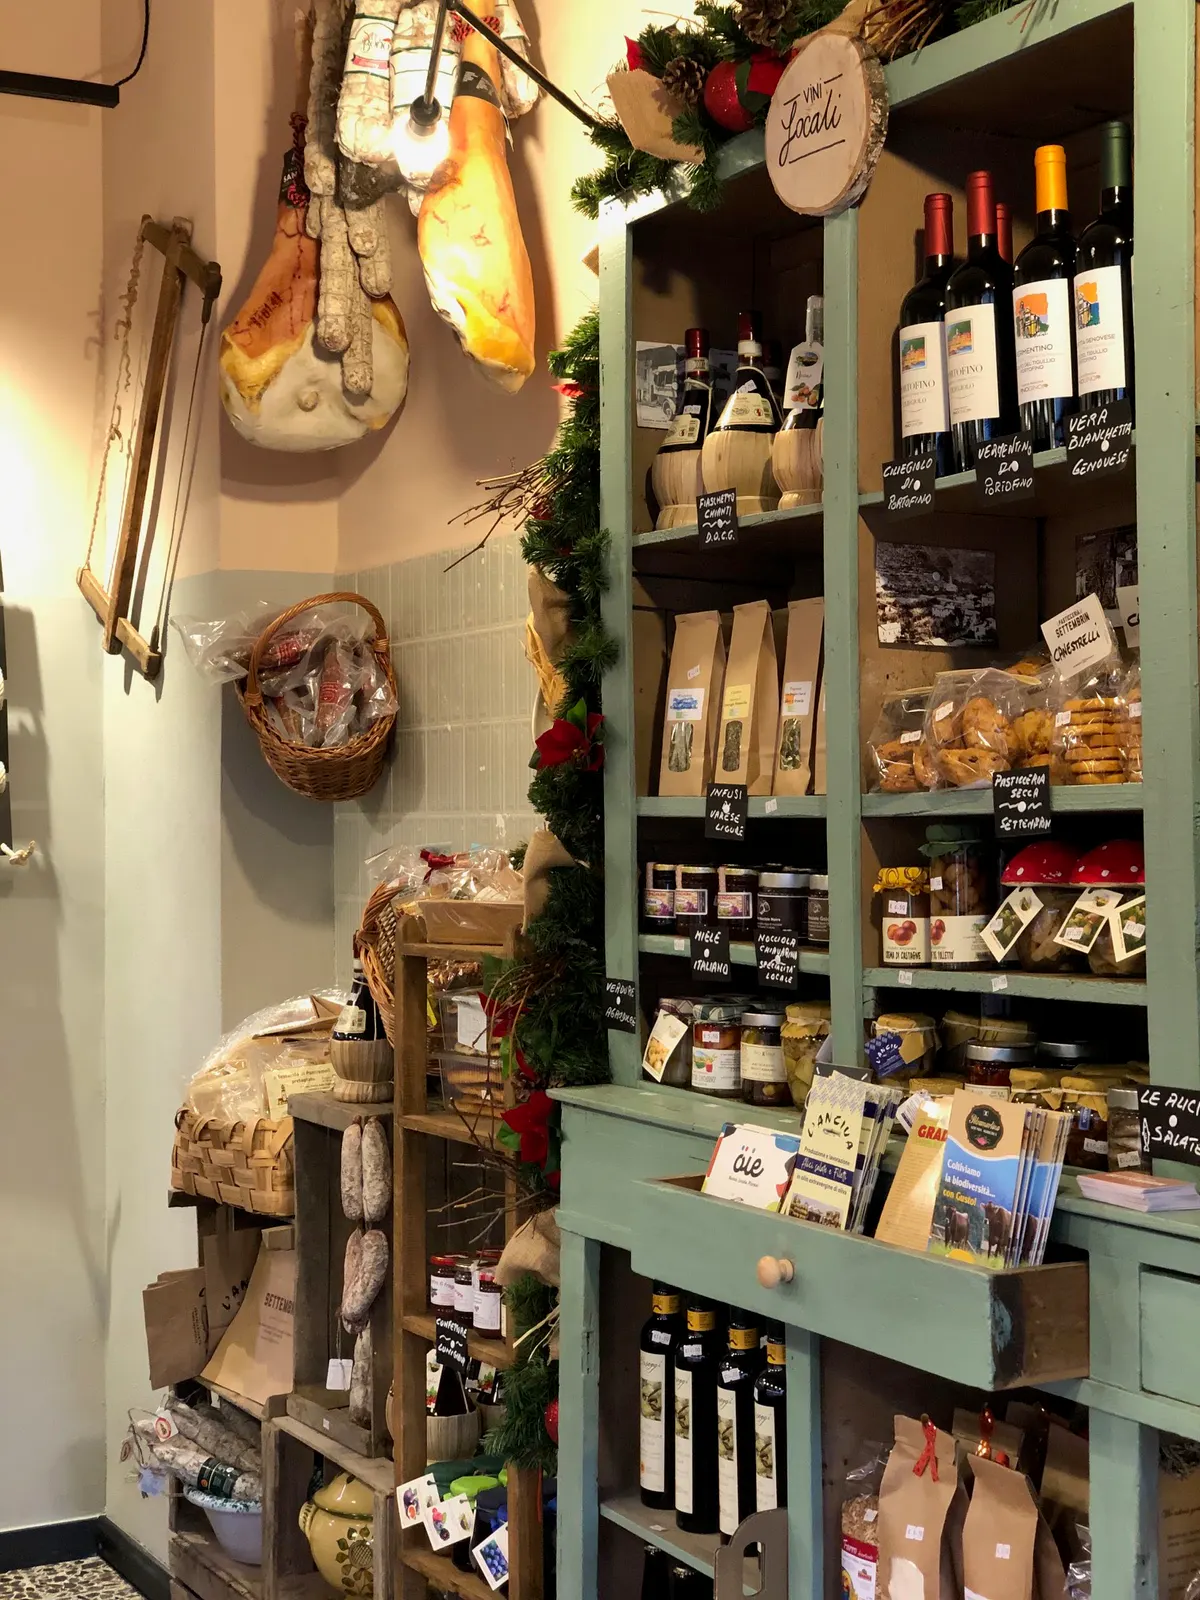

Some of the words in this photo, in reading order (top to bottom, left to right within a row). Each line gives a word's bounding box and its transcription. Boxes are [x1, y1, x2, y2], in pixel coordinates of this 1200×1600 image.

[803, 77, 823, 103] VINI
[1068, 407, 1109, 434] VERA
[1068, 421, 1134, 452] BIANCHETTA
[978, 435, 1033, 461] VERMENTINO
[1071, 449, 1129, 477] GENOVESE
[984, 476, 1034, 497] PORTOFINO
[699, 492, 736, 509] FIASCHETTO
[888, 493, 933, 512] PORTOFINO
[704, 505, 733, 519] CHIANTI
[705, 529, 736, 544] D.O.C.G.
[1055, 612, 1091, 639] SETTEMBRIN
[1053, 622, 1101, 662] CANESTRELLI
[710, 788, 743, 800] INFUSI
[1010, 787, 1039, 799] SECCA
[710, 810, 741, 824] VARESE
[715, 824, 744, 837] LIGURE
[694, 930, 722, 945] MIELE
[757, 933, 796, 948] NOCCIOLA
[693, 959, 729, 976] ITALIANO
[765, 971, 794, 984] LOCALE
[606, 982, 636, 998] VERDURE
[876, 1043, 899, 1064] L'ANCIU
[1141, 1090, 1161, 1106] LE
[804, 1146, 826, 1159] Produzione
[829, 1154, 851, 1166] lavorazione
[947, 1158, 982, 1179] Coltiviamo
[808, 1178, 833, 1192] extravergine
[944, 1173, 952, 1183] la
[943, 1189, 954, 1199] con
[955, 1191, 977, 1207] Gusto!
